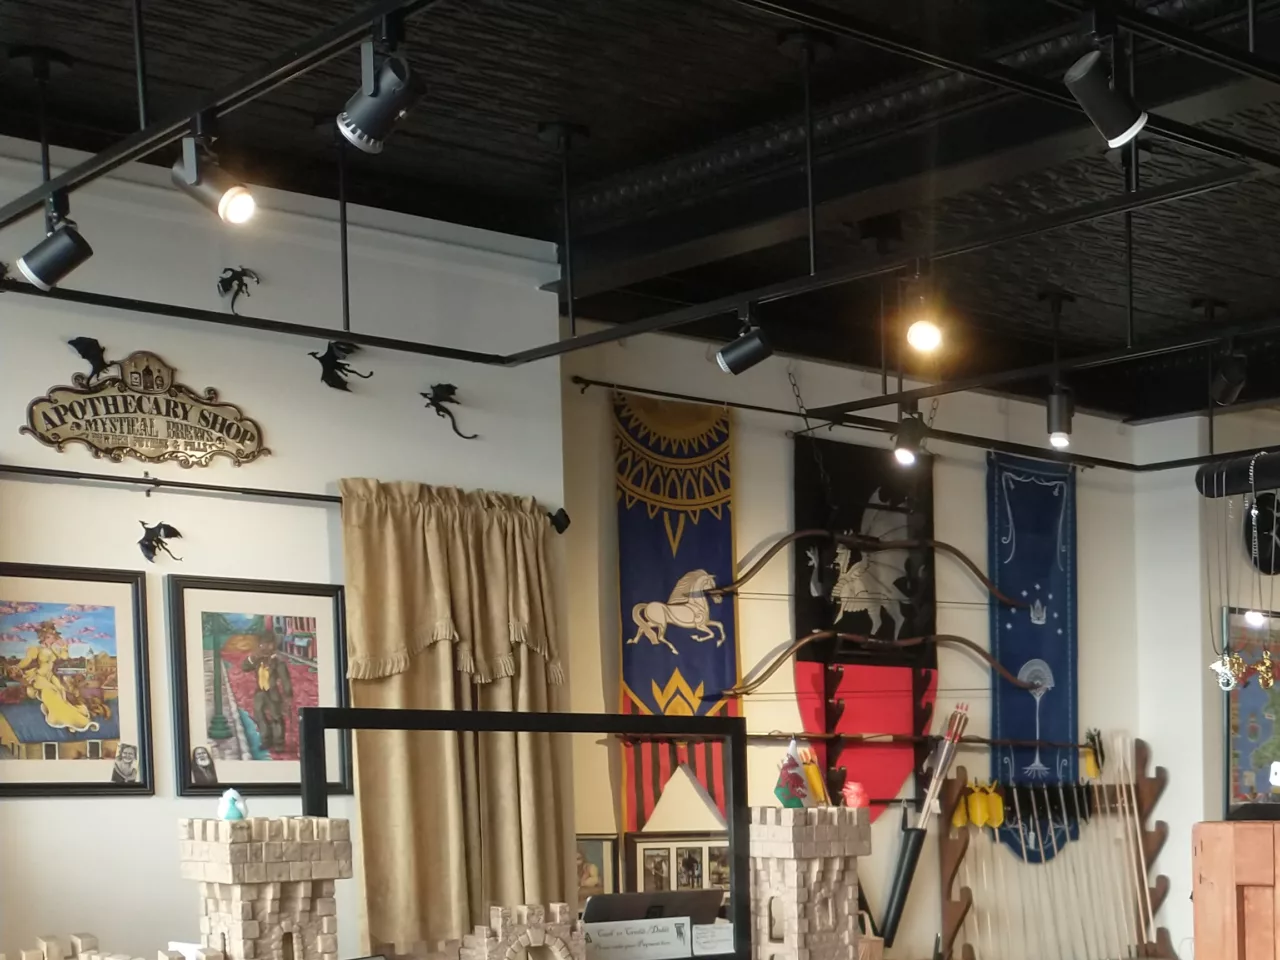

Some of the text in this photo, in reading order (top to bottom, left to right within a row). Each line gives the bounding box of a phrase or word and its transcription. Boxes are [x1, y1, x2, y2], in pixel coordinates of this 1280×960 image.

[40, 394, 256, 446] APOTHECARY SHOP
[84, 416, 213, 442] MYSTICAL BREWS
